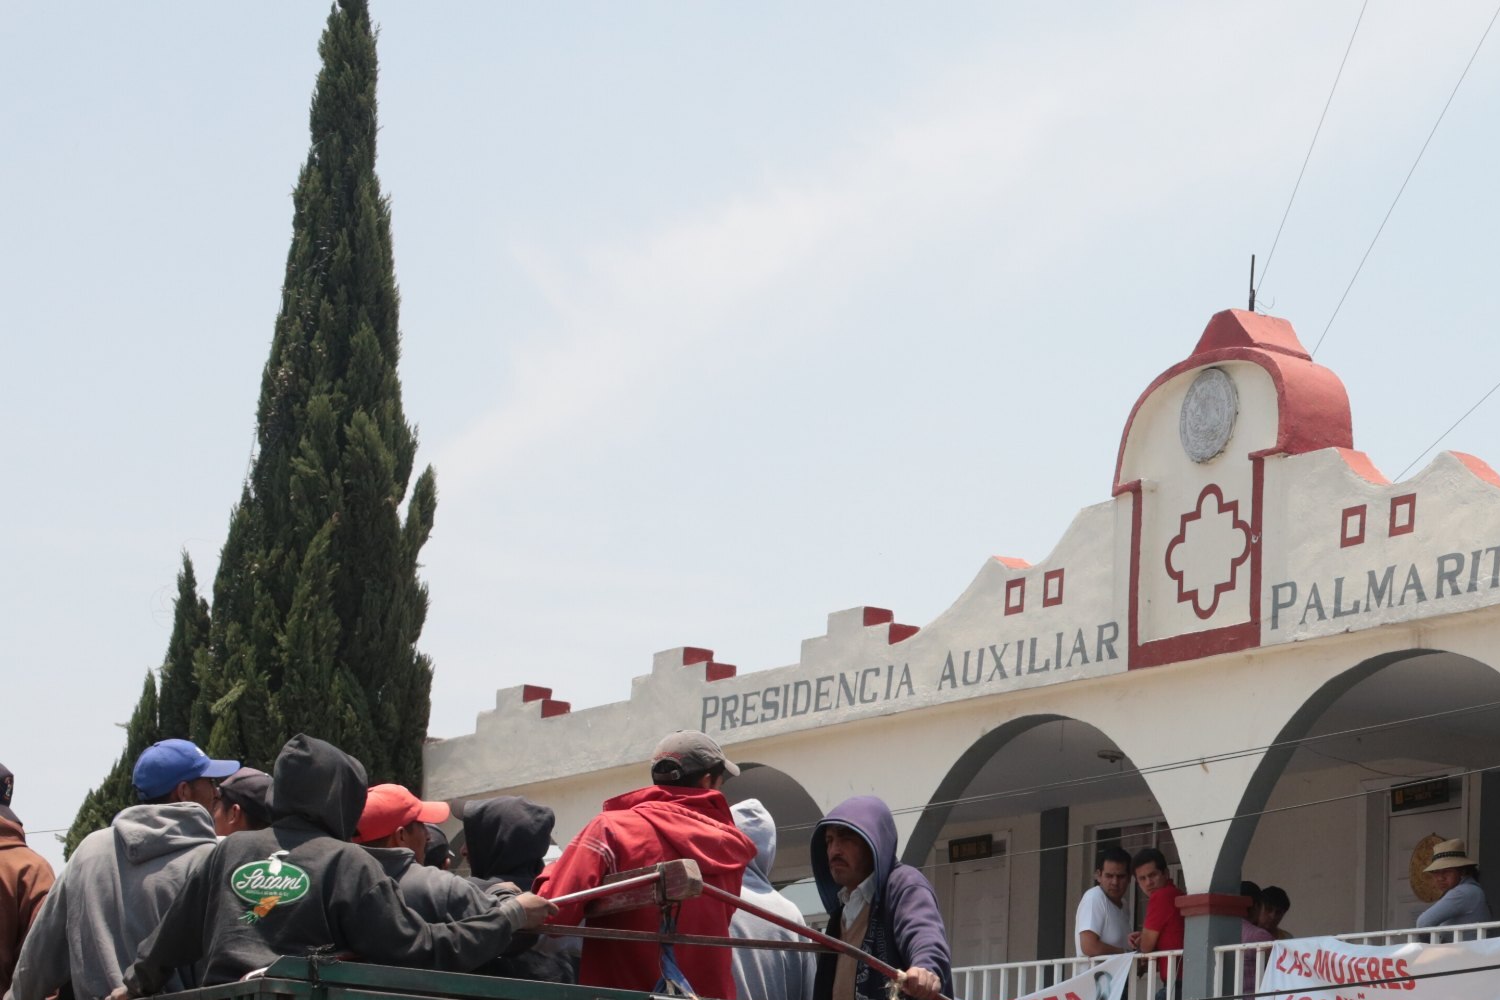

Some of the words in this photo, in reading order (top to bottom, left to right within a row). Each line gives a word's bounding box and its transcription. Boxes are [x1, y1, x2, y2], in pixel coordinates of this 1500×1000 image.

[701, 664, 916, 733] PRESIDENCIA
[937, 621, 1120, 691] AUXILIAR
[1276, 948, 1311, 978] LAS
[1314, 949, 1416, 990] MUJERES
